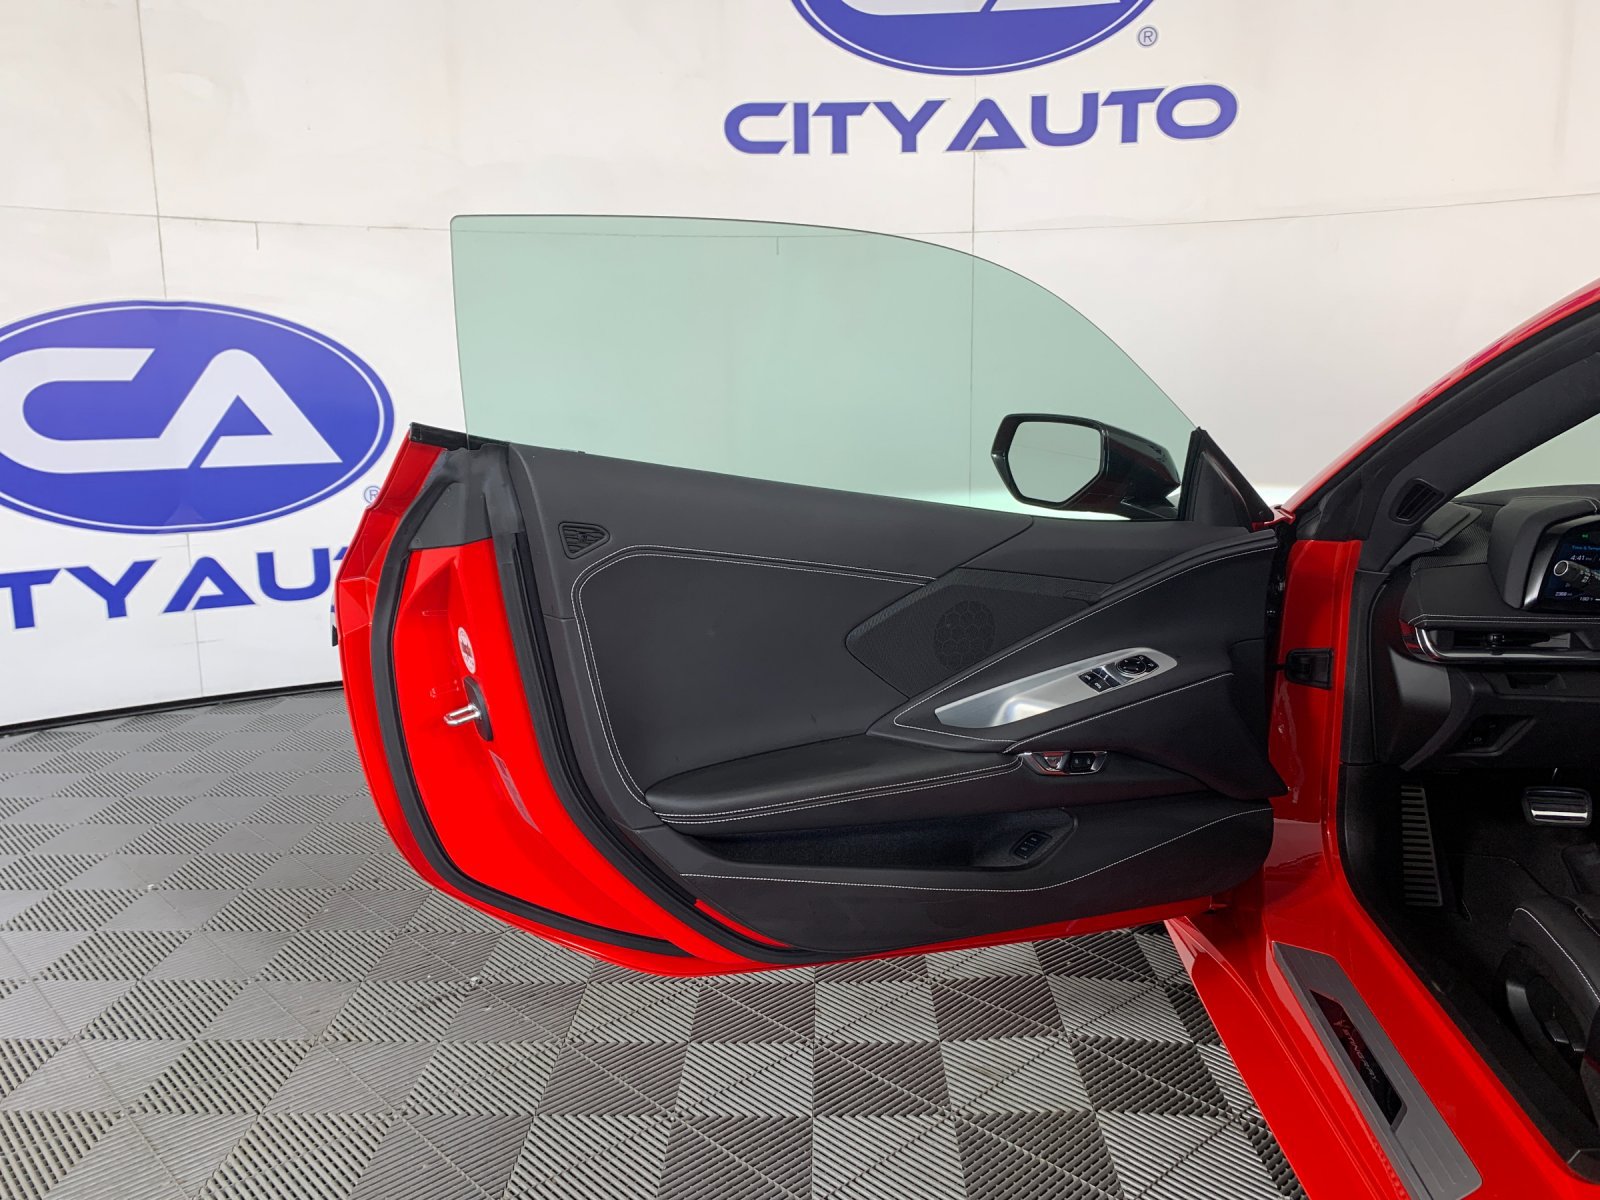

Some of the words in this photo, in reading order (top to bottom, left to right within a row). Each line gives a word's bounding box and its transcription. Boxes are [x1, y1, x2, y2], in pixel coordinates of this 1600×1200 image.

[724, 100, 949, 154] CITY
[945, 84, 1238, 152] AUTO
[0, 347, 343, 474] CA
